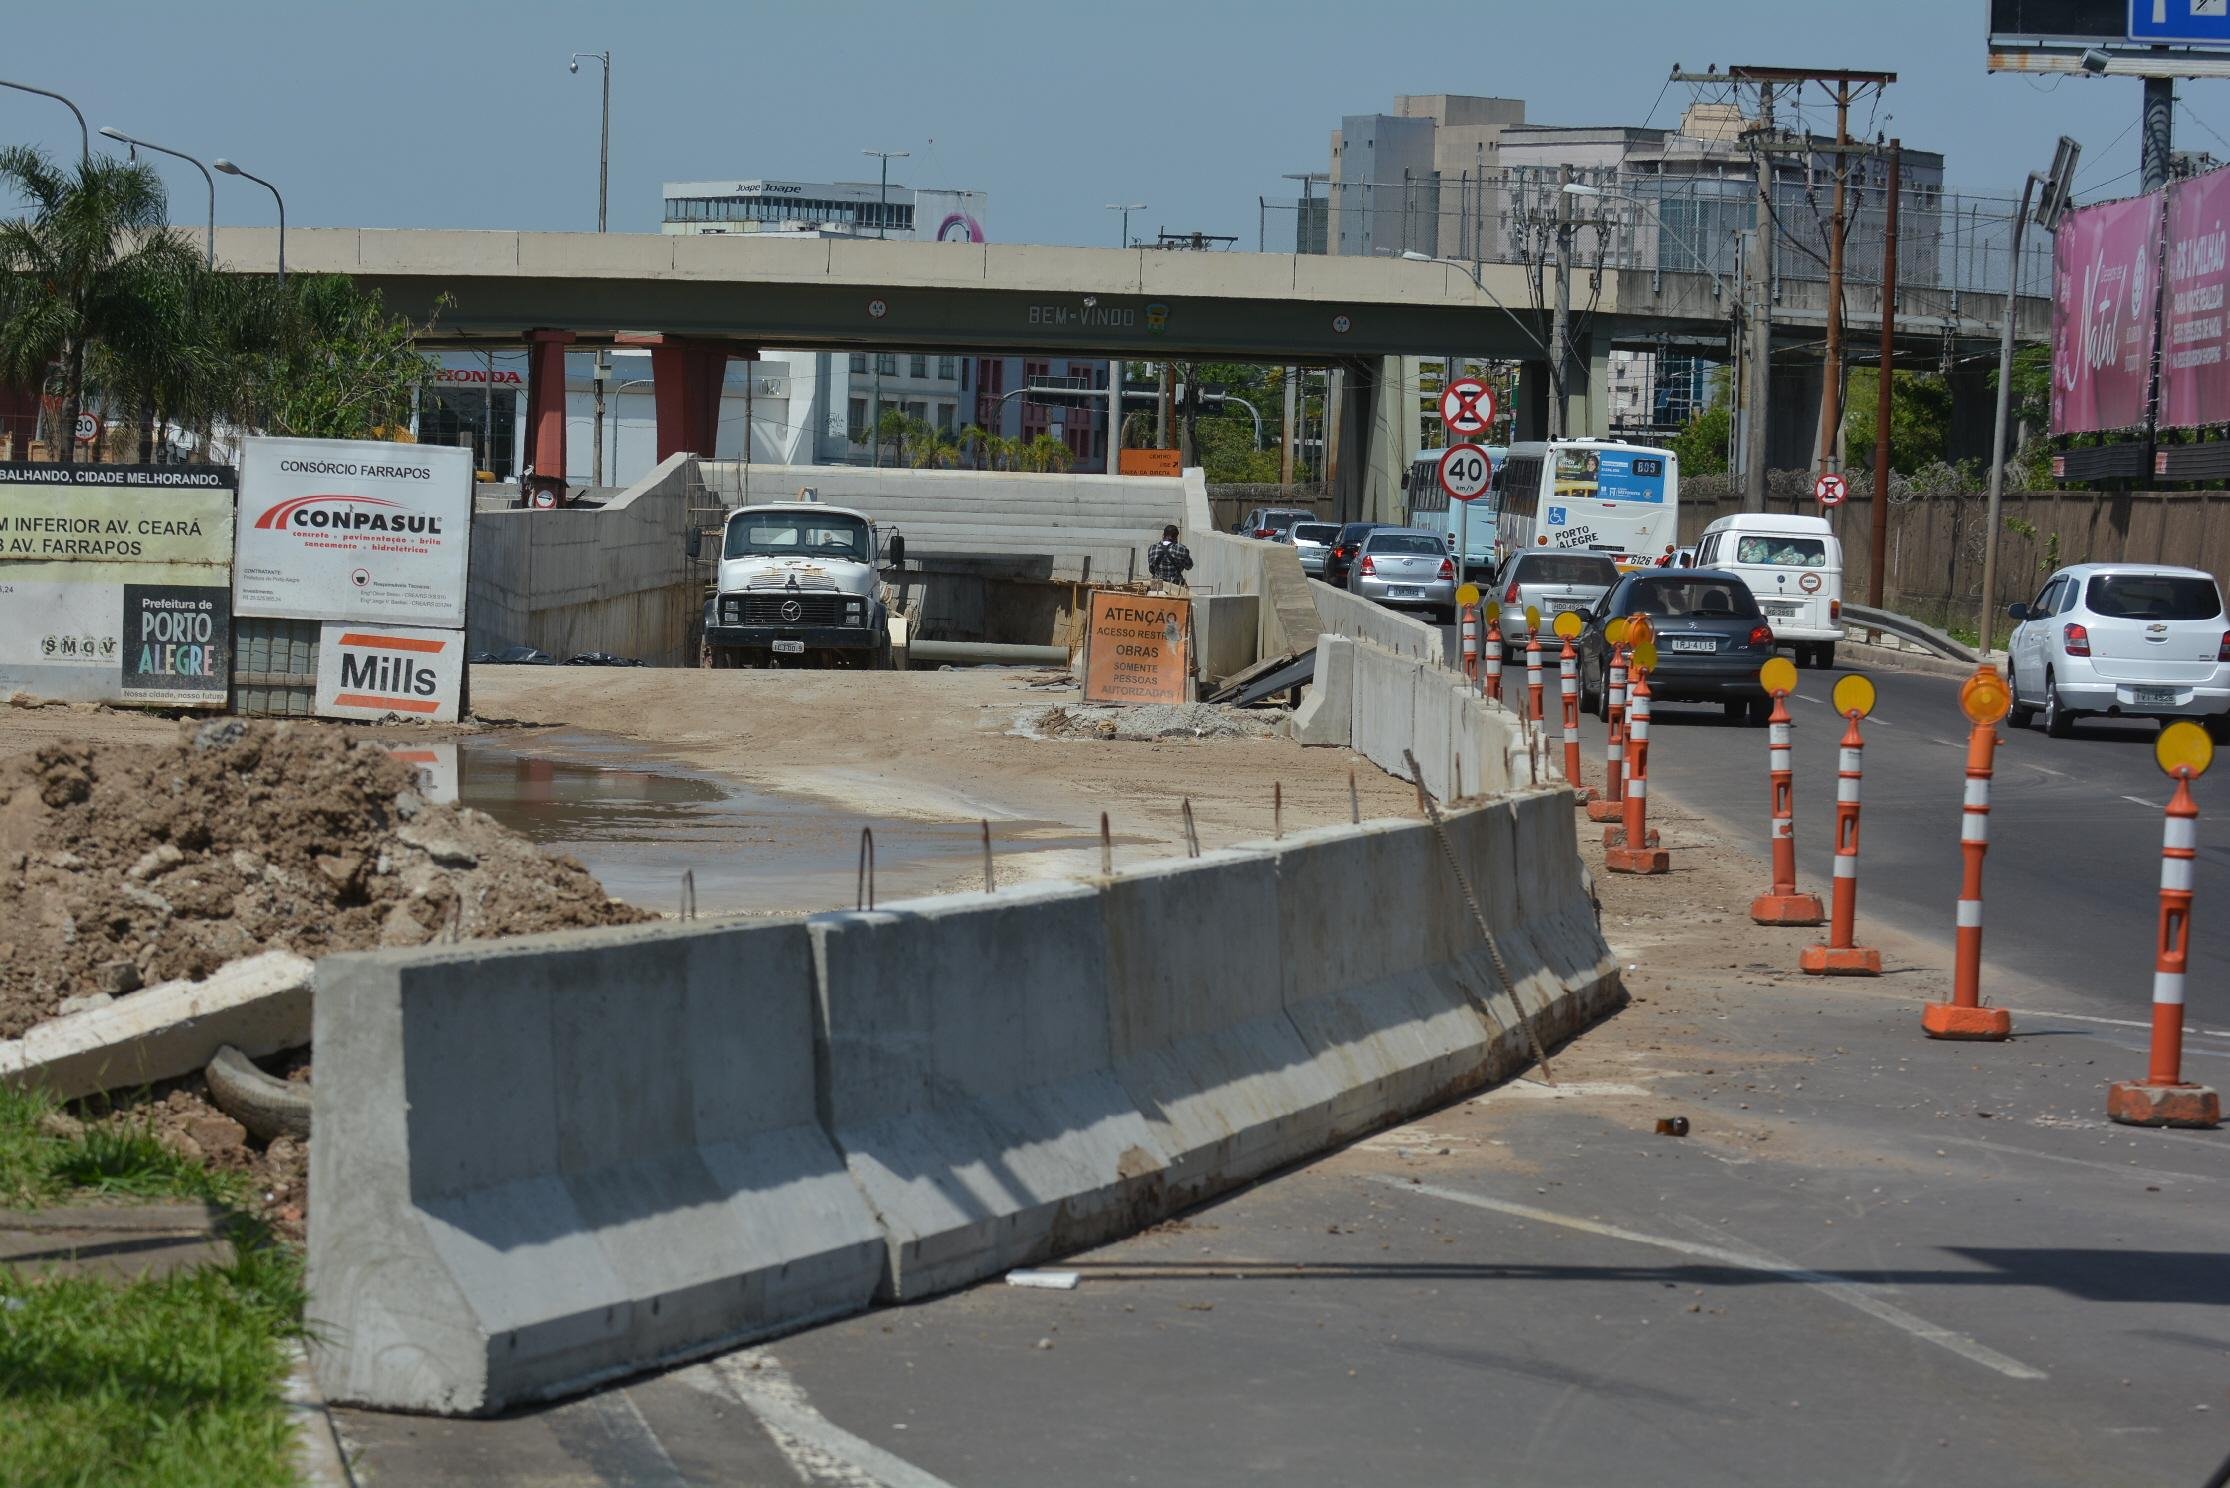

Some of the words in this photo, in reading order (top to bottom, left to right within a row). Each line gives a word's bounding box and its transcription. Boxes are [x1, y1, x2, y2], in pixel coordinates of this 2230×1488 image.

[736, 184, 761, 193] Joape
[764, 184, 802, 193] Joape
[1028, 306, 1135, 327] BEM-VINDO
[2062, 247, 2127, 391] Natal
[434, 369, 522, 383] HONDA
[75, 420, 93, 432] 30
[280, 460, 357, 476] CONSÓRCIO
[360, 466, 431, 480] FARRAPOS
[1448, 458, 1483, 482] 40
[76, 471, 125, 484] CIDADE
[127, 473, 223, 486] MELHORANDO.
[15, 517, 100, 534] INFERIOR
[105, 520, 131, 535] AV.
[138, 518, 202, 536] CEARÁ
[293, 509, 442, 535] CONPASUL
[1555, 526, 1590, 541] PORTO
[1557, 532, 1599, 549] ALEGRE
[10, 539, 36, 553] AV.
[43, 540, 142, 555] FARRAPOS
[1630, 555, 1653, 566] 6126
[142, 598, 196, 610] Prefeitura
[198, 600, 213, 610] de
[1104, 607, 1178, 626] ATENÇÃO
[142, 611, 212, 642] PORTO
[1097, 627, 1136, 638] ACESSO
[1116, 644, 1159, 658] OBRAS
[138, 644, 215, 676] ALEGRE
[1113, 661, 1158, 673] SOMENTE
[340, 653, 437, 696] Mills
[1113, 674, 1158, 686] PESSOAS
[124, 690, 148, 698] Nossa
[149, 690, 176, 699] cidade,
[1101, 685, 1174, 698] AUTORIZADAS
